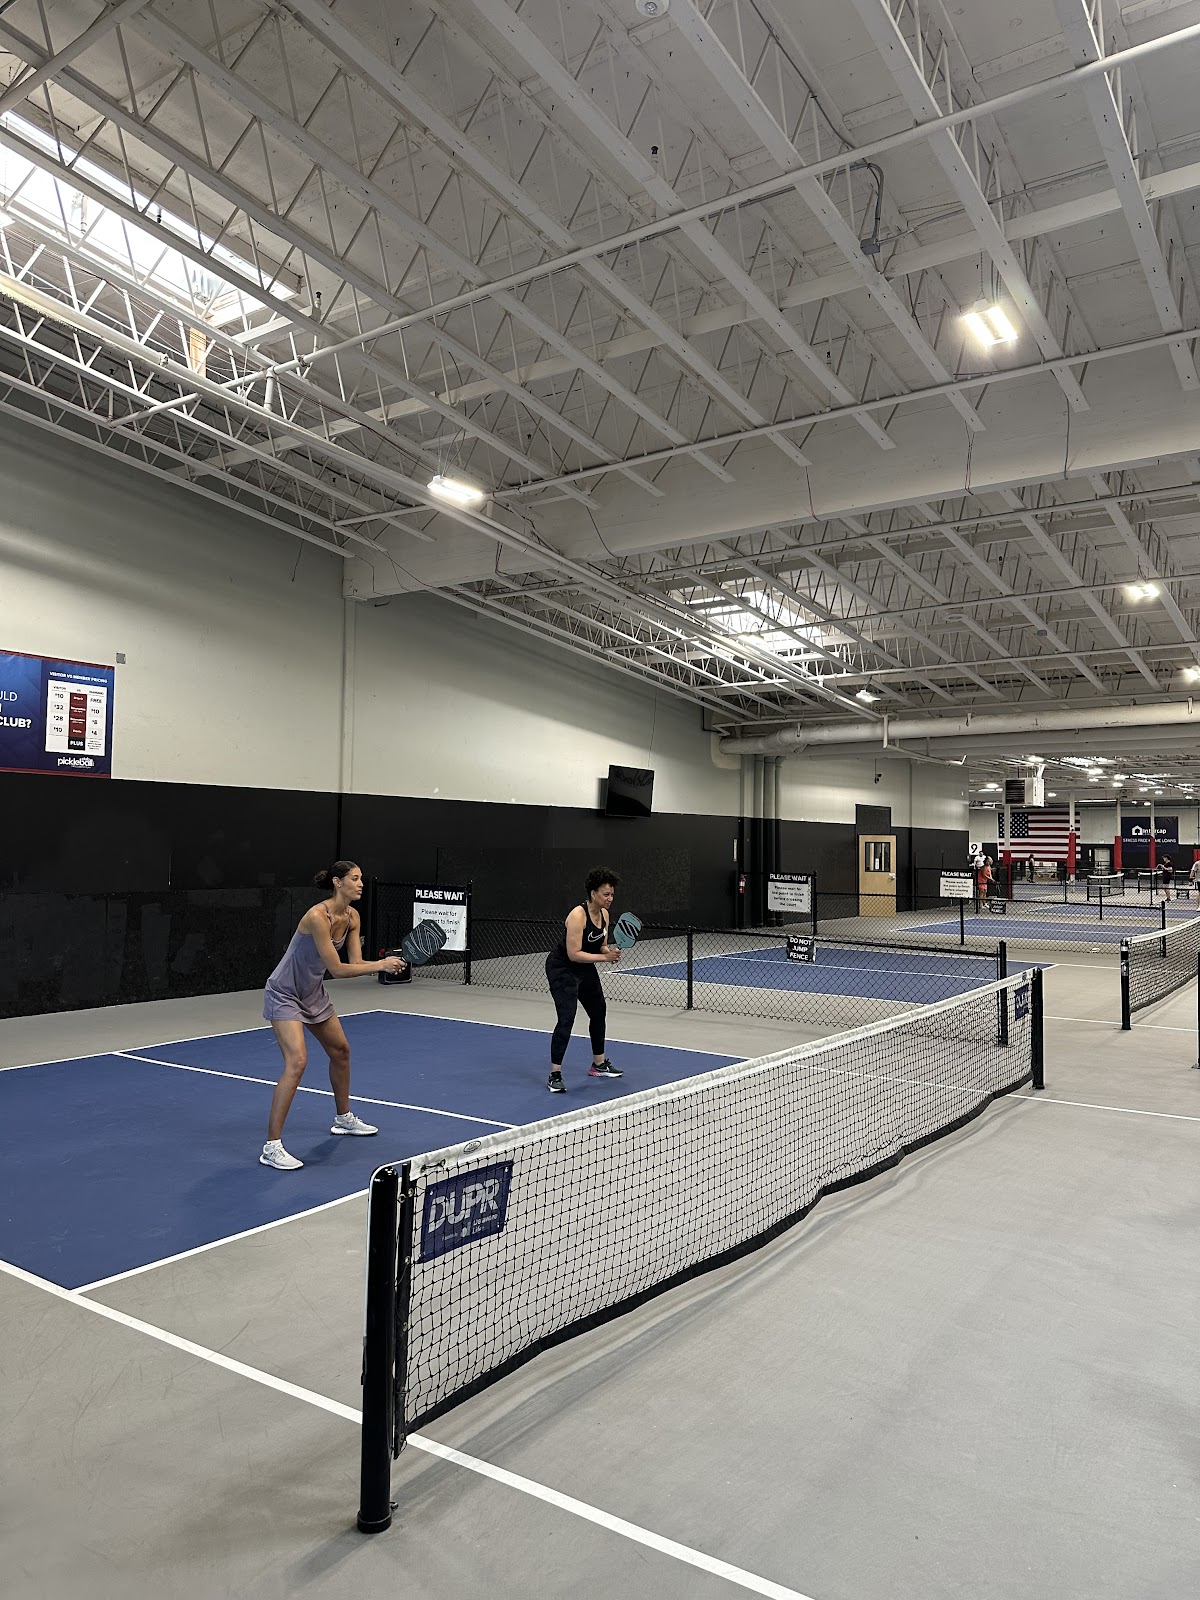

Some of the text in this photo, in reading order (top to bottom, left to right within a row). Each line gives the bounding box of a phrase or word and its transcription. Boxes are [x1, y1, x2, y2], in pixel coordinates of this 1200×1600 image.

[57, 757, 94, 766] pickleball
[970, 843, 978, 854] 9
[770, 873, 791, 881] PLEASE
[415, 889, 465, 901] PLEASE WAIT
[799, 938, 811, 946] NOT
[428, 1179, 500, 1233] DUPR
